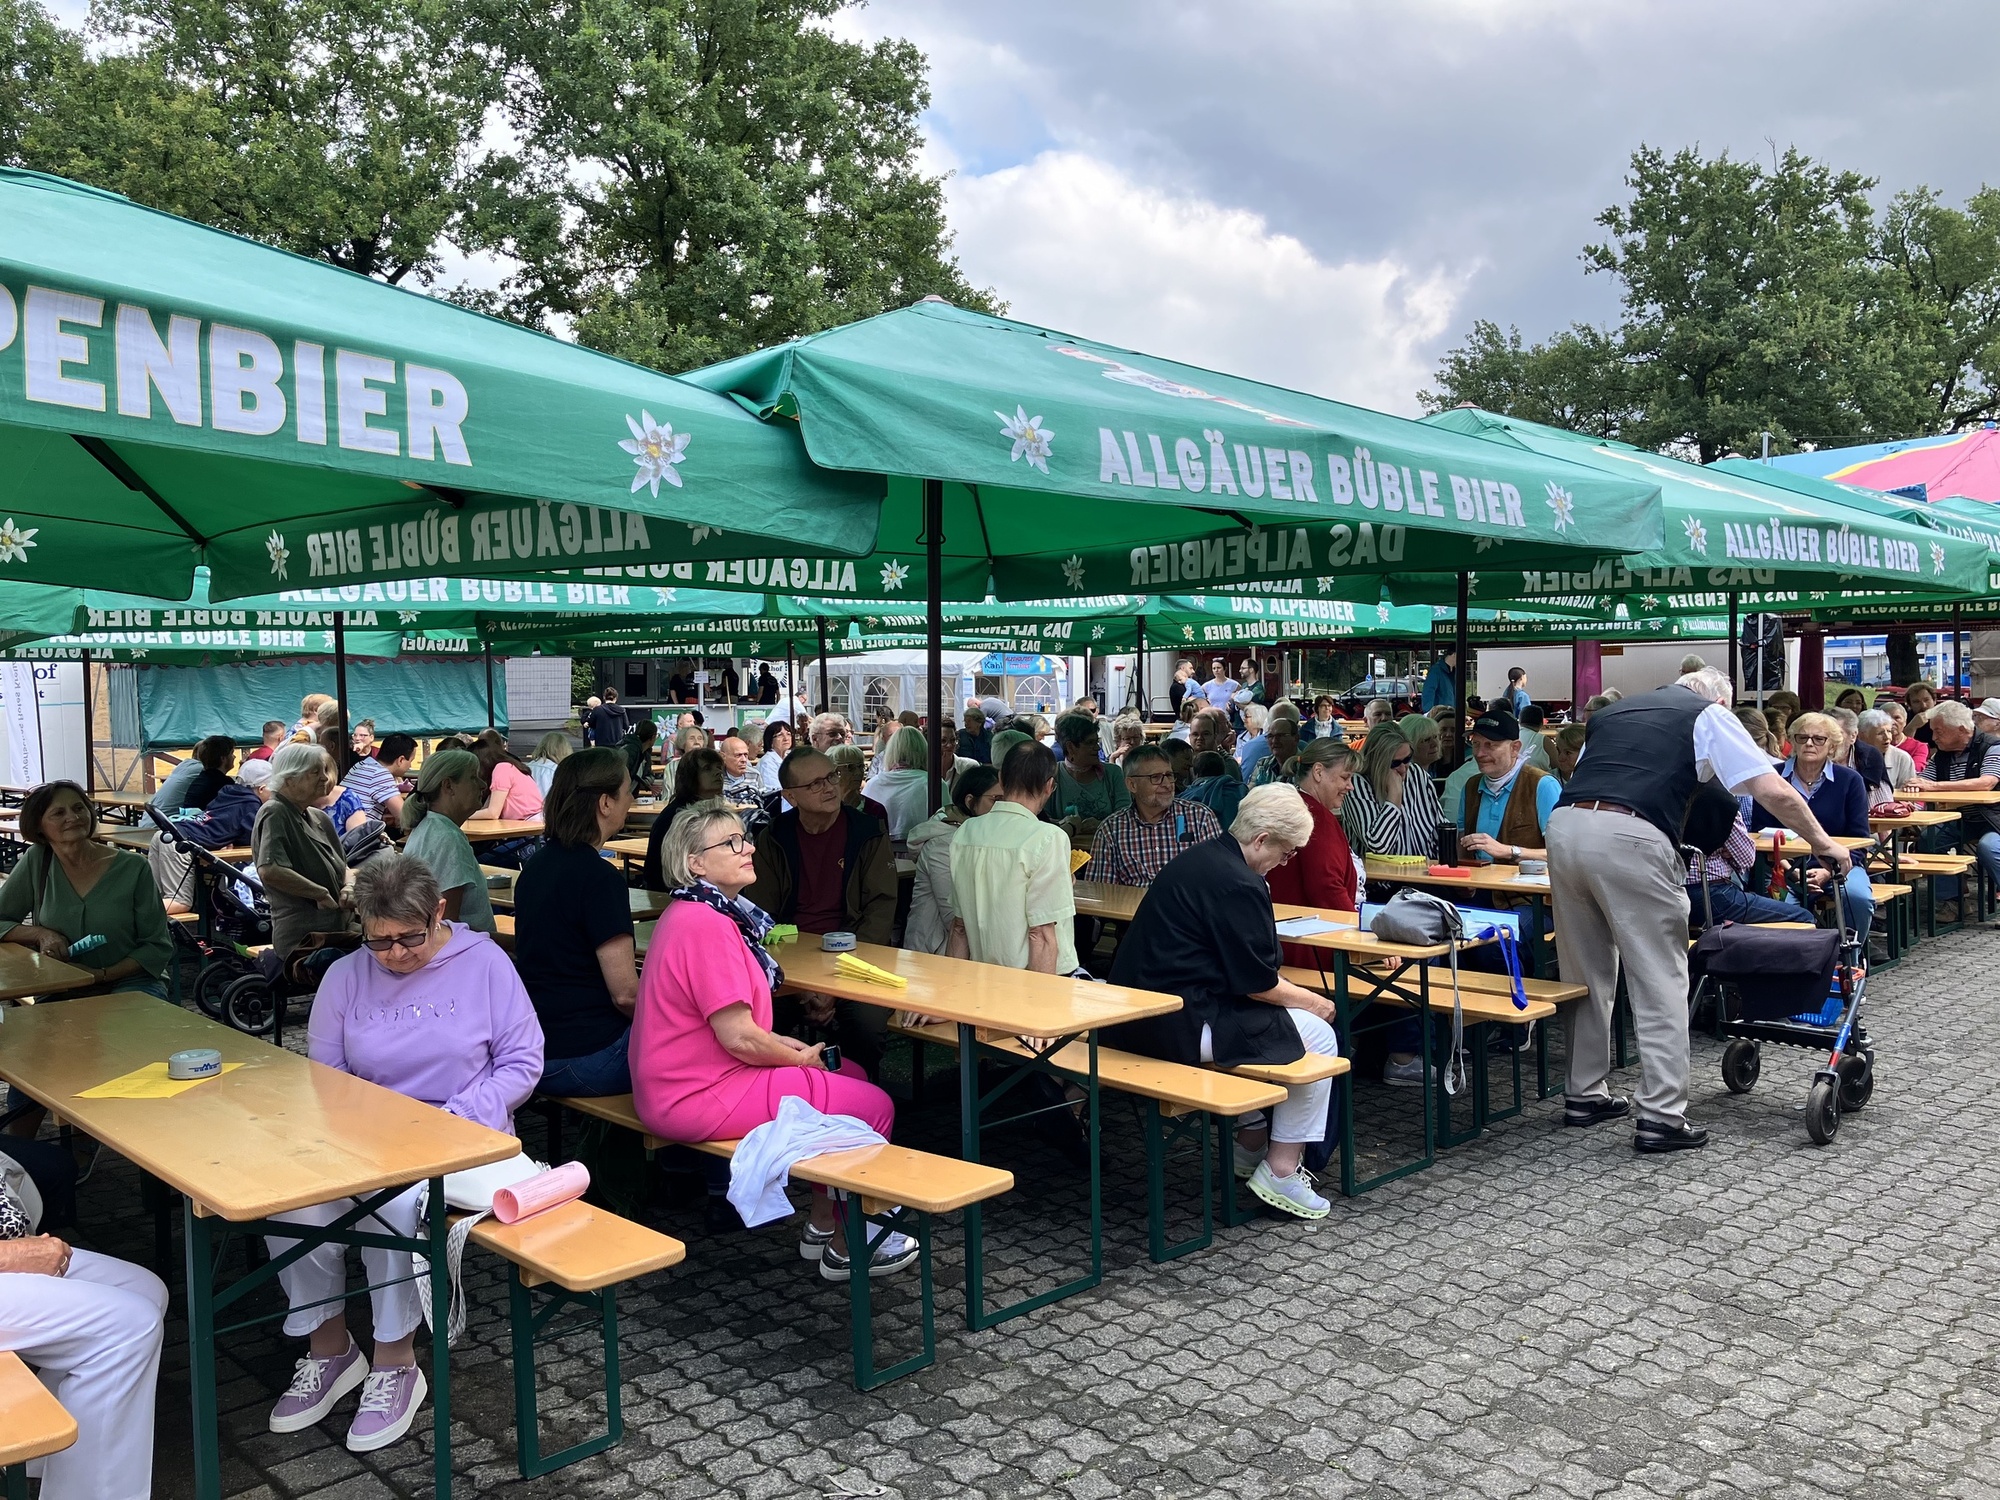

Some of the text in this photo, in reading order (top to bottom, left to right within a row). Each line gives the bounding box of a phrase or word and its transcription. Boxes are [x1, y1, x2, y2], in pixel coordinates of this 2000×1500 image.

[0, 282, 474, 467] ENBIER
[1099, 427, 1527, 528] ALLGÄUER BÜBLE BIER
[1723, 516, 1921, 573] ALLGÄUER BÜBLE BIER
[567, 585, 631, 605] BIER
[1231, 597, 1356, 621] DAS ALPENBIER
[258, 630, 306, 647] BIER
